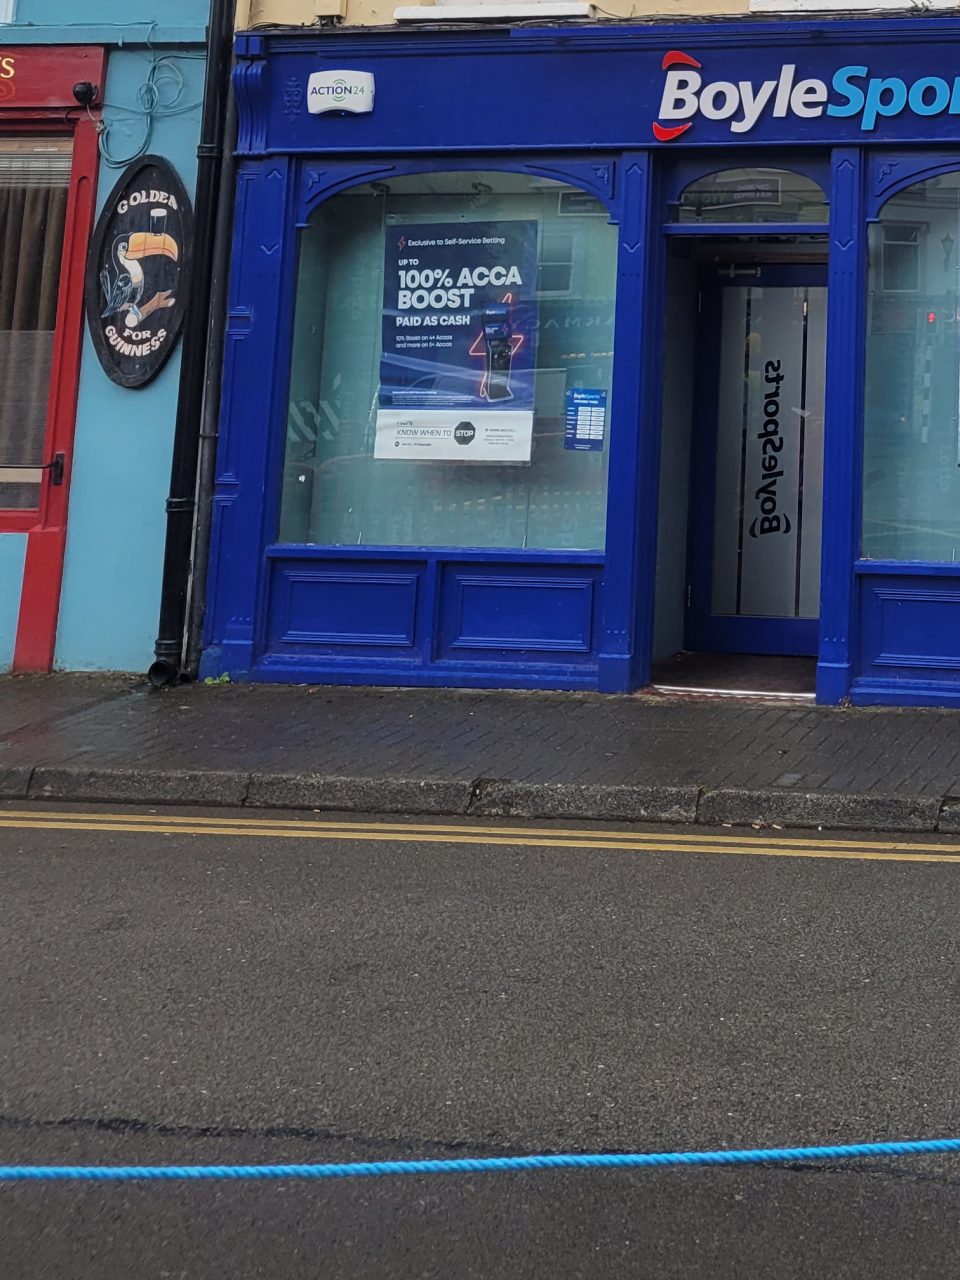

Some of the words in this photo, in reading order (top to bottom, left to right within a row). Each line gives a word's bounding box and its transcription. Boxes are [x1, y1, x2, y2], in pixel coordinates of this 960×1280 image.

[116, 189, 178, 214] GOLDEN
[407, 239, 436, 247] Exclusive
[444, 237, 481, 245] Self-Service
[482, 236, 506, 245] Betting
[409, 258, 419, 266] TO
[398, 269, 454, 288] 100%
[456, 265, 523, 287] ACCA
[398, 288, 475, 310] BOOST
[396, 316, 422, 327] PAID
[423, 315, 438, 326] AS
[440, 315, 470, 326] CASH
[105, 325, 167, 357] GUINNESS
[123, 328, 151, 341] FOR
[420, 429, 441, 437] WHEN
[455, 429, 474, 437] STOP
